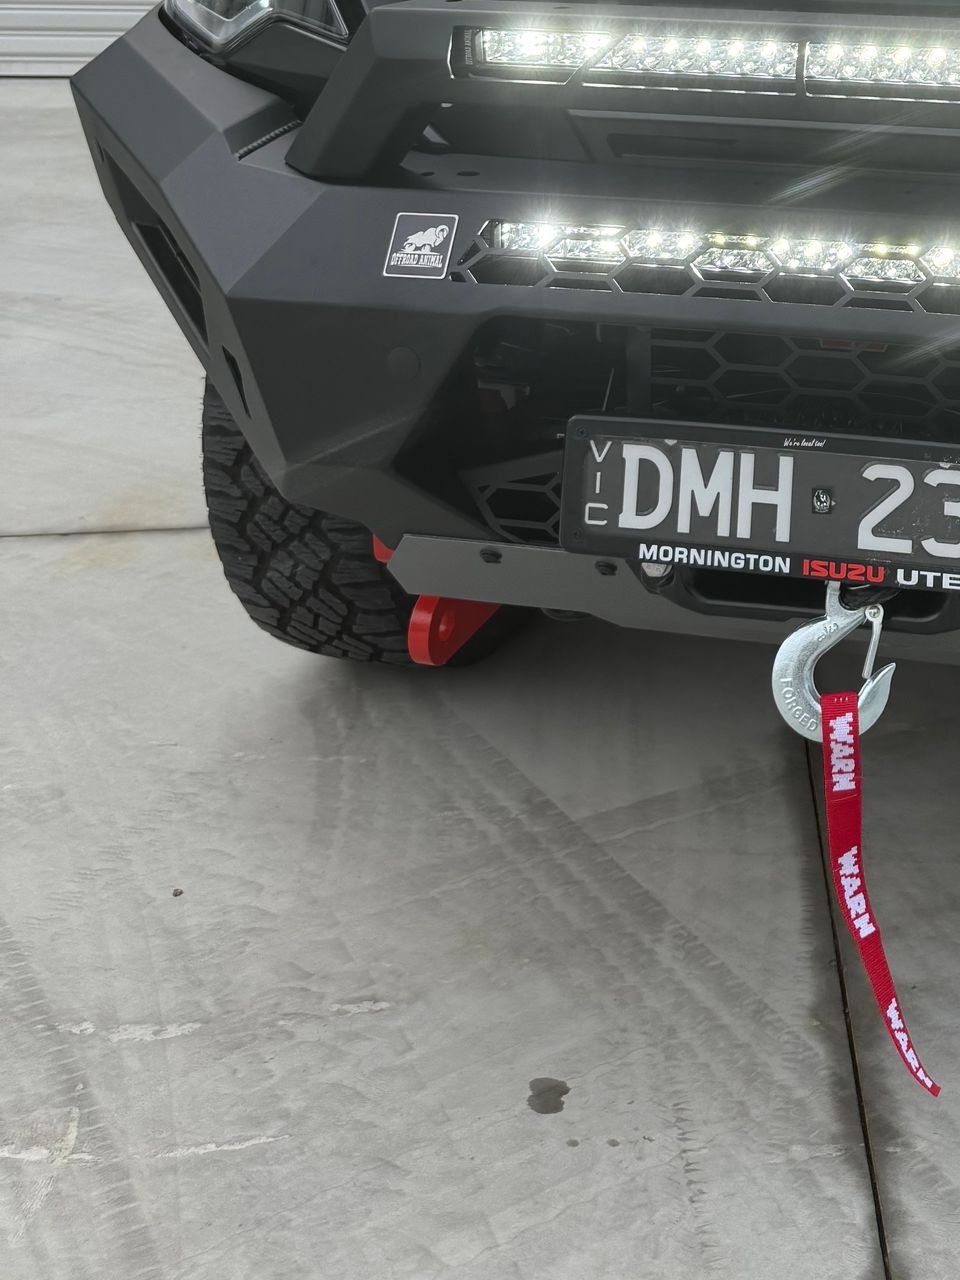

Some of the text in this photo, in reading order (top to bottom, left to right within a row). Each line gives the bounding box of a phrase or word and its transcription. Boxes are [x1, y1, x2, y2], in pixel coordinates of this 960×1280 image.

[390, 252, 444, 268] OFFROAD ANIMAL
[584, 440, 613, 525] VIC
[618, 443, 794, 542] DMH
[639, 543, 791, 574] MORNINGTON
[803, 559, 885, 583] ISUZU
[779, 677, 819, 733] FORGED
[829, 712, 856, 792] WARN
[837, 845, 877, 939] WARN
[886, 997, 933, 1089] WARN
